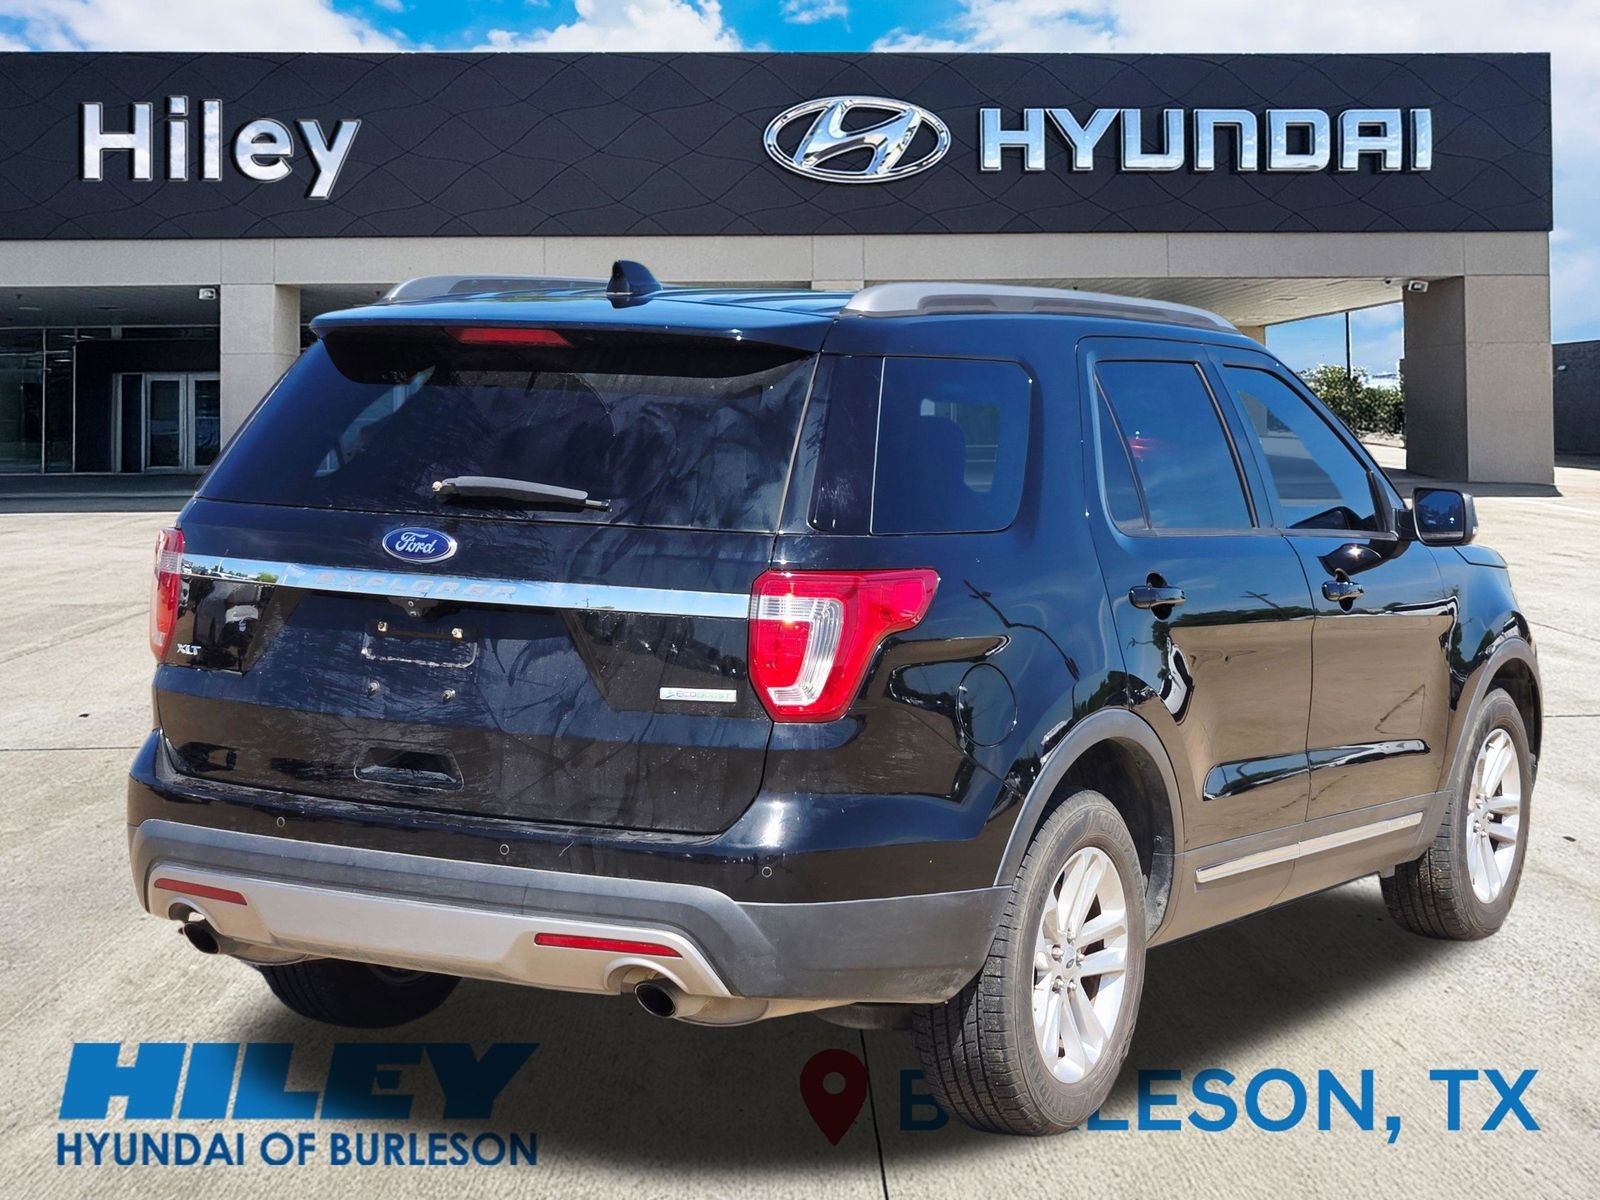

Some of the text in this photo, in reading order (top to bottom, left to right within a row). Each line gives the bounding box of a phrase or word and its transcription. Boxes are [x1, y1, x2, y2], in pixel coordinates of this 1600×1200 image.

[81, 95, 362, 200] Hiley
[978, 107, 1433, 172] HYUNDAI
[395, 532, 438, 554] Ford
[315, 571, 517, 600] EXPLORER
[176, 643, 202, 656] XLT
